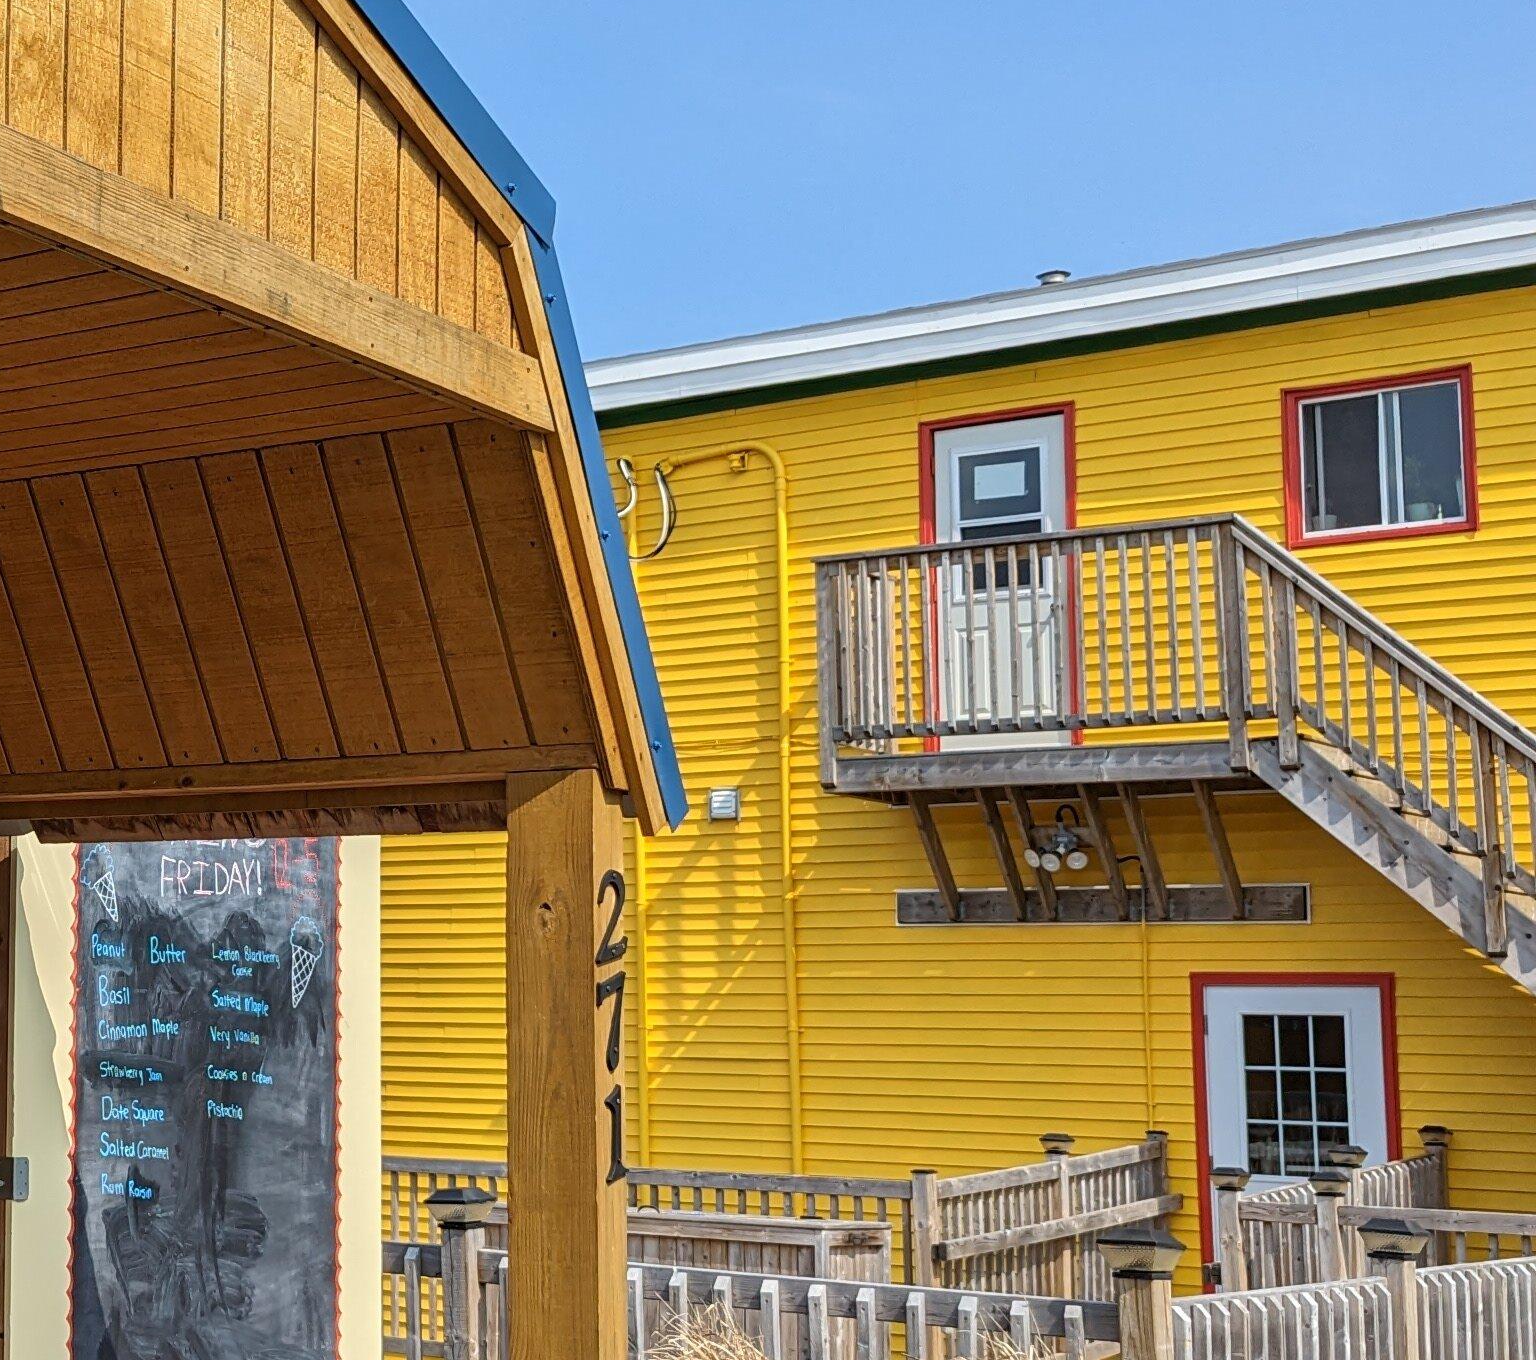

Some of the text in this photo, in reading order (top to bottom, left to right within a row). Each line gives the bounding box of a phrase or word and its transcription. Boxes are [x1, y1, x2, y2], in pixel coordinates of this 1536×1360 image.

[160, 854, 262, 898] FRIDAY!
[91, 933, 187, 964] Peanut Butter
[98, 974, 130, 1007] Basil
[244, 997, 270, 1018] Maple
[98, 1018, 179, 1040] Cinnamon Maple
[209, 1025, 230, 1049] Very
[99, 1061, 163, 1086] Strawberry Jam
[101, 1095, 165, 1127] Date Square
[207, 1098, 244, 1121] Pistachio
[99, 1131, 170, 1161] Salted Caramel
[101, 1173, 154, 1200] Rum Raisin
